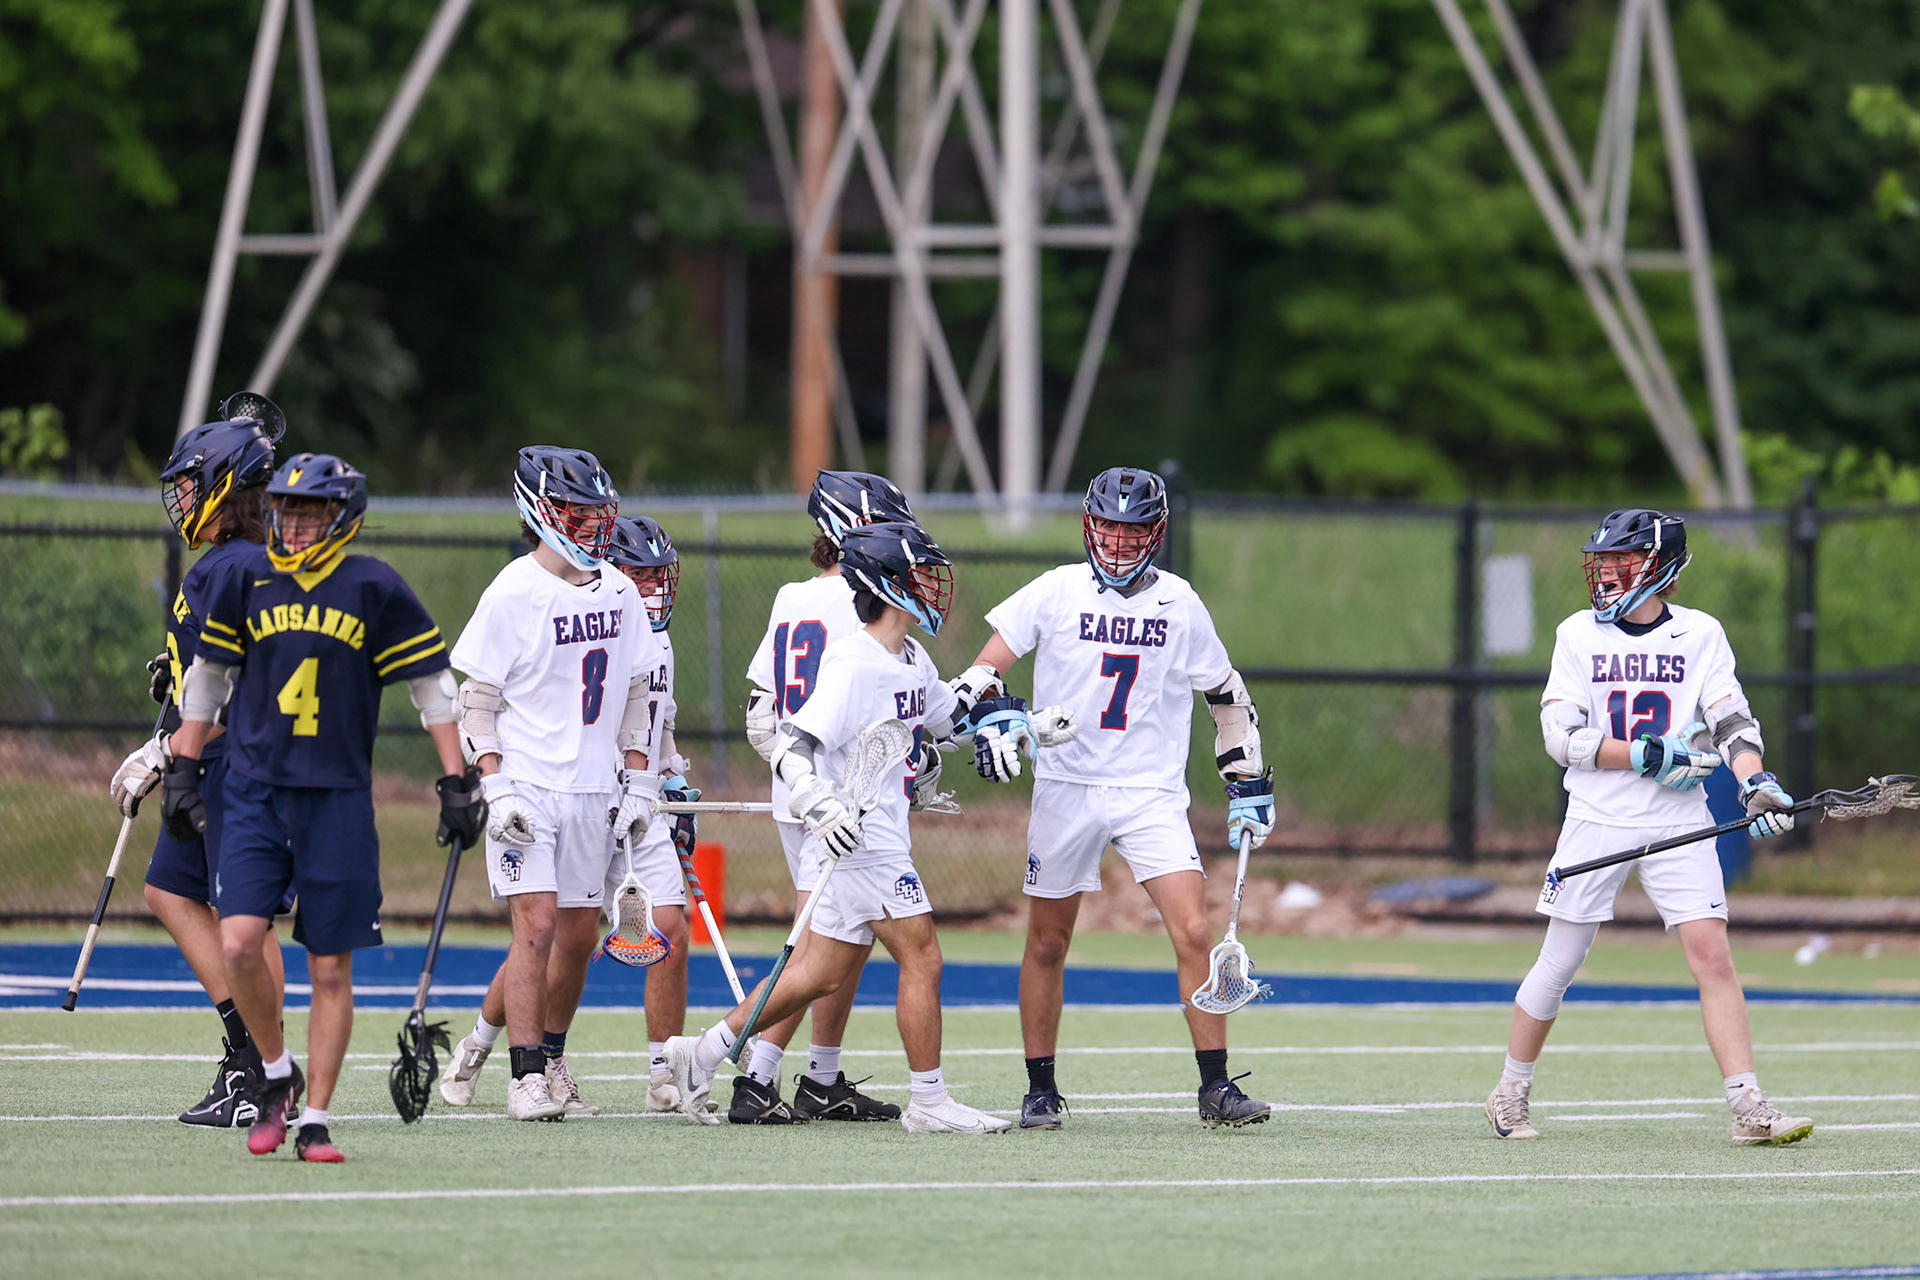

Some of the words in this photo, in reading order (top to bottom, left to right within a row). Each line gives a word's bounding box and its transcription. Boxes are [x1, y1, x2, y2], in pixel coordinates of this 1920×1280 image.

[246, 603, 366, 651] LAUSANNE
[1079, 612, 1168, 647] EAGLES
[582, 647, 609, 726] 8
[773, 619, 828, 720] 13
[1100, 652, 1140, 731] 7
[1591, 653, 1686, 683] EAGLES
[277, 657, 319, 737] 4
[894, 686, 926, 721] EAG
[1607, 690, 1671, 742] 12
[894, 879, 923, 904] SBA
